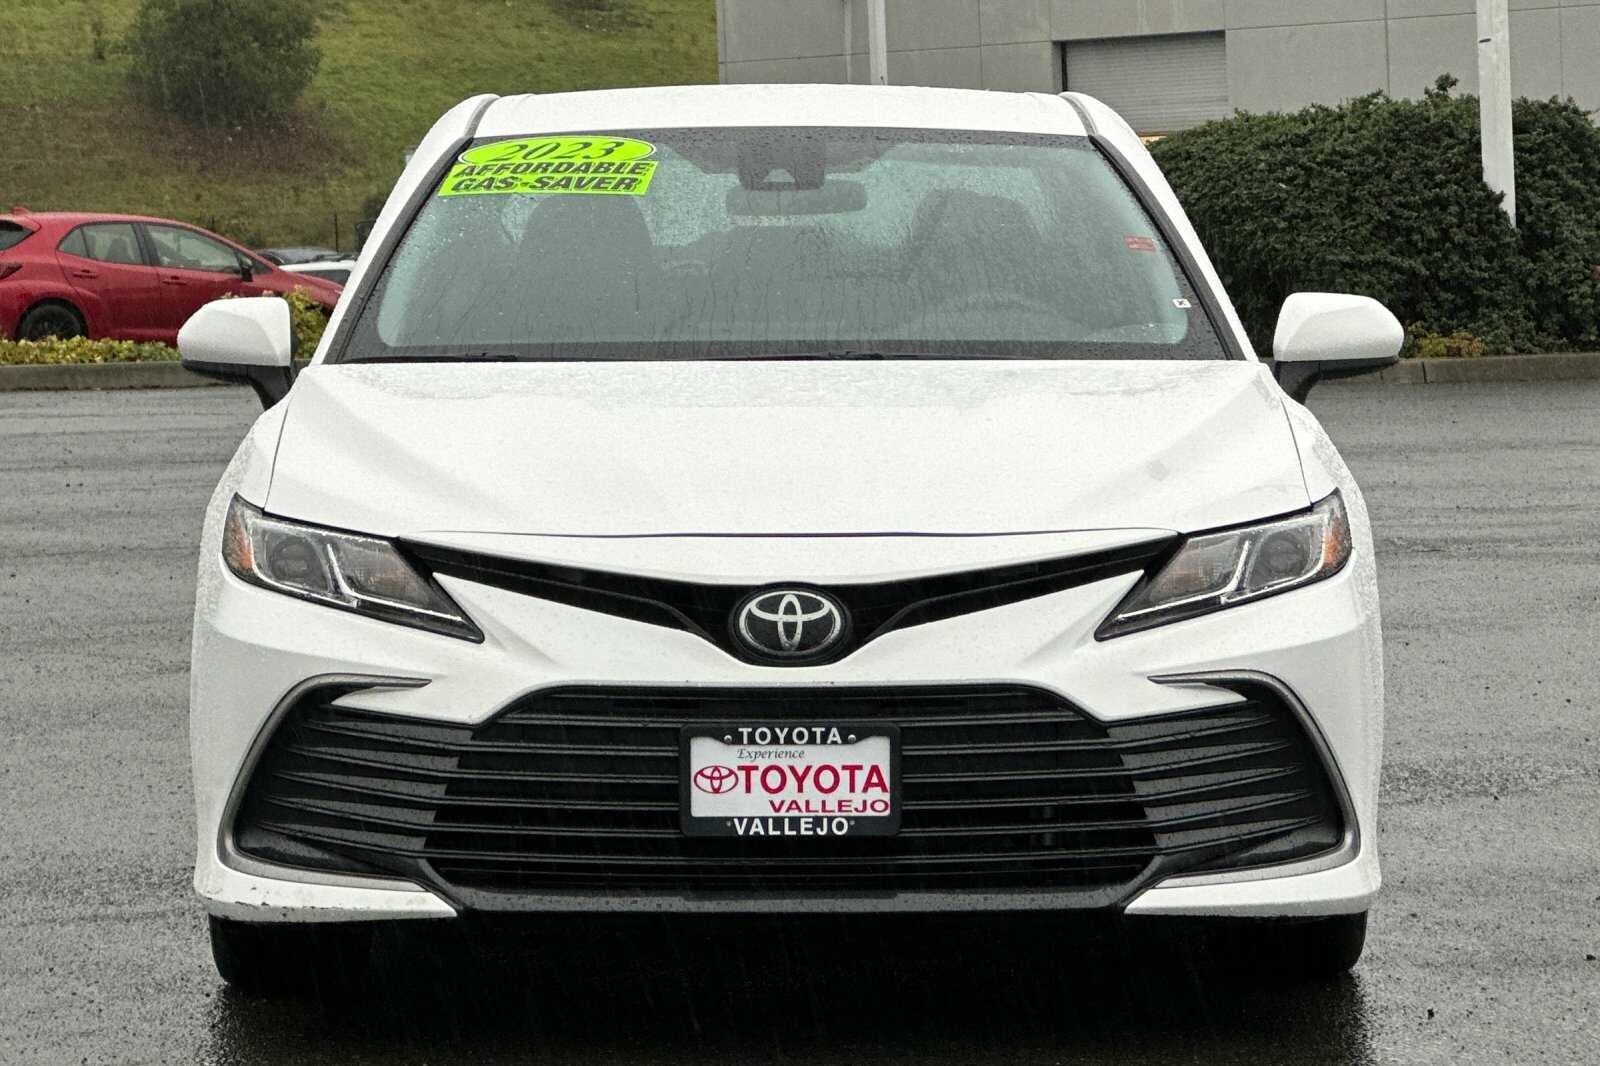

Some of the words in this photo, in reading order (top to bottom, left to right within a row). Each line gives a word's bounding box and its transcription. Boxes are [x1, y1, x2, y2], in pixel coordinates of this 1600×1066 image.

[491, 141, 625, 162] 2023
[453, 161, 649, 177] AFFORDABLE
[738, 727, 842, 745] TOYOTA
[737, 748, 805, 760] Experience
[737, 764, 889, 794] TOYOTA
[768, 799, 890, 813] VALLEJO
[733, 817, 849, 836] VALLEJO
